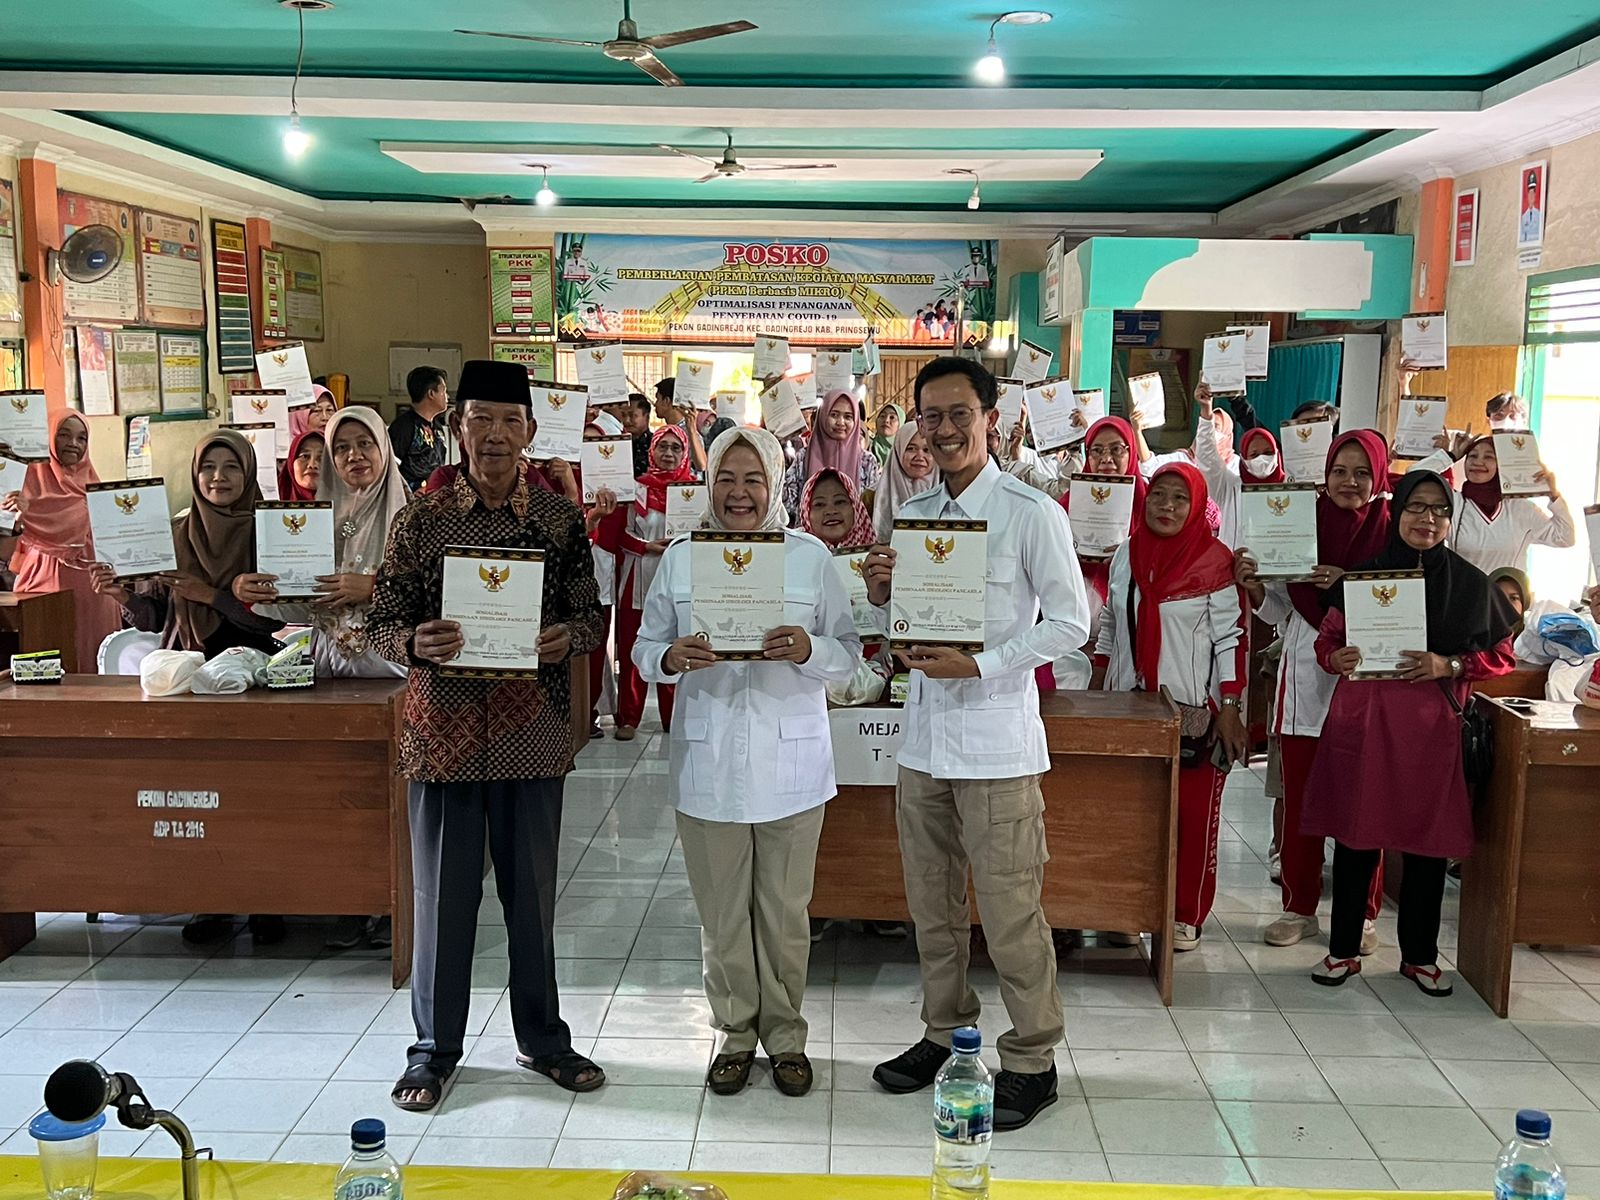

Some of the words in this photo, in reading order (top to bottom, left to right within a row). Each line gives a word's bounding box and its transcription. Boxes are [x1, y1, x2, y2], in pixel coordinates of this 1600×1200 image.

[723, 242, 830, 266] POSKO
[617, 269, 712, 280] PEMBERLAKUAN
[715, 271, 793, 283] PEMBATASAN
[795, 272, 856, 284] KEGIATAN
[857, 273, 935, 284] MASYARAKAT
[707, 284, 746, 297] (PPKM
[748, 285, 796, 296] Berbasis
[798, 286, 845, 298] MIKRO)
[697, 300, 776, 309] OPTIMALISASI
[780, 300, 853, 310] PENANGANAN
[712, 311, 782, 320] PENYEBARAN
[787, 312, 837, 321] COVID-19
[668, 323, 693, 331] PEKON
[697, 323, 743, 332] GADINGREJO
[746, 323, 763, 332] KEC.
[766, 325, 812, 333] GADINGREJO
[835, 326, 881, 335] PRINGSEWU
[860, 723, 900, 735] MEJA
[872, 749, 881, 761] T
[137, 790, 165, 808] PEKON
[167, 790, 219, 808] GADINGREJO
